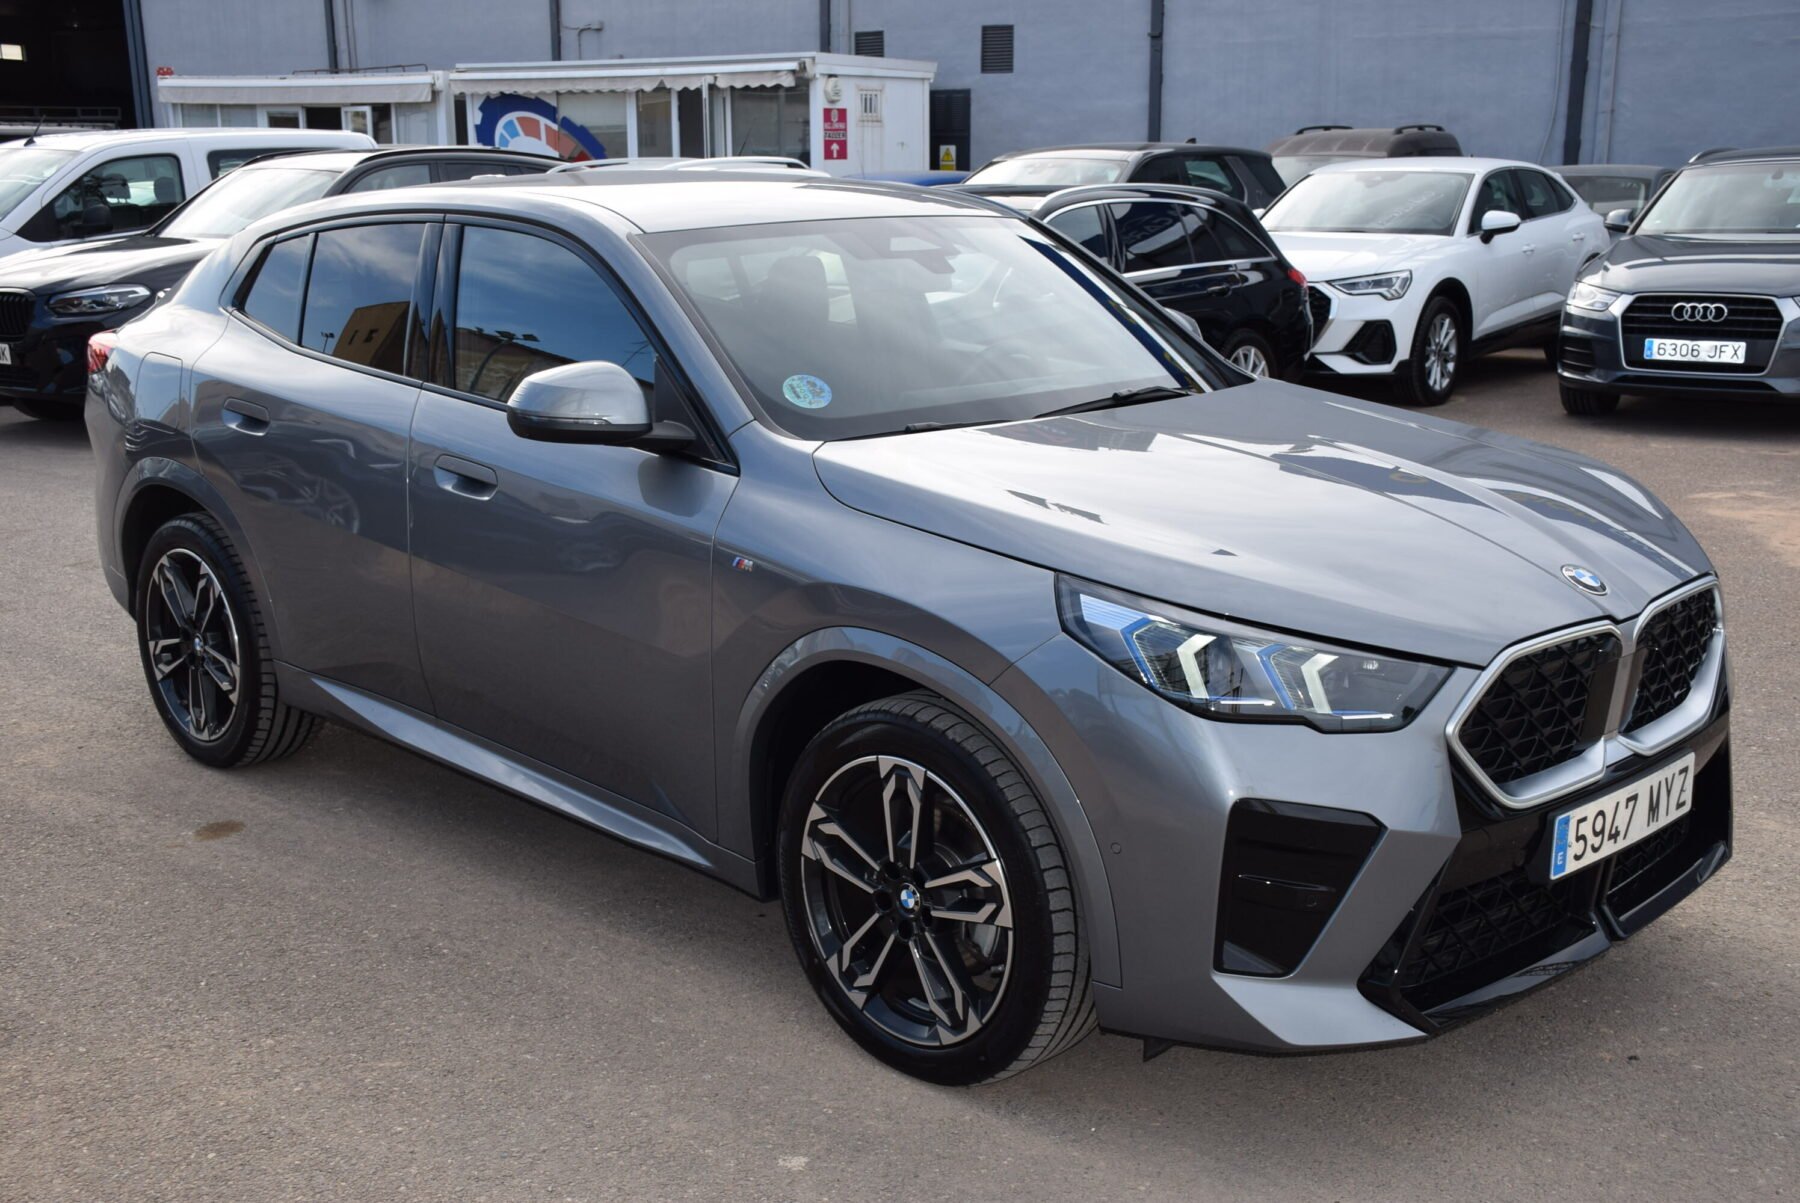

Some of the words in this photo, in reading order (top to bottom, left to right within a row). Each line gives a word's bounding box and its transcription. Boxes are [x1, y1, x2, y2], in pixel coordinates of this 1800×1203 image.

[1657, 342, 1701, 358] 6306
[1707, 344, 1741, 360] JFX
[1573, 793, 1639, 862] 5947
[1647, 765, 1689, 827] MYZ
